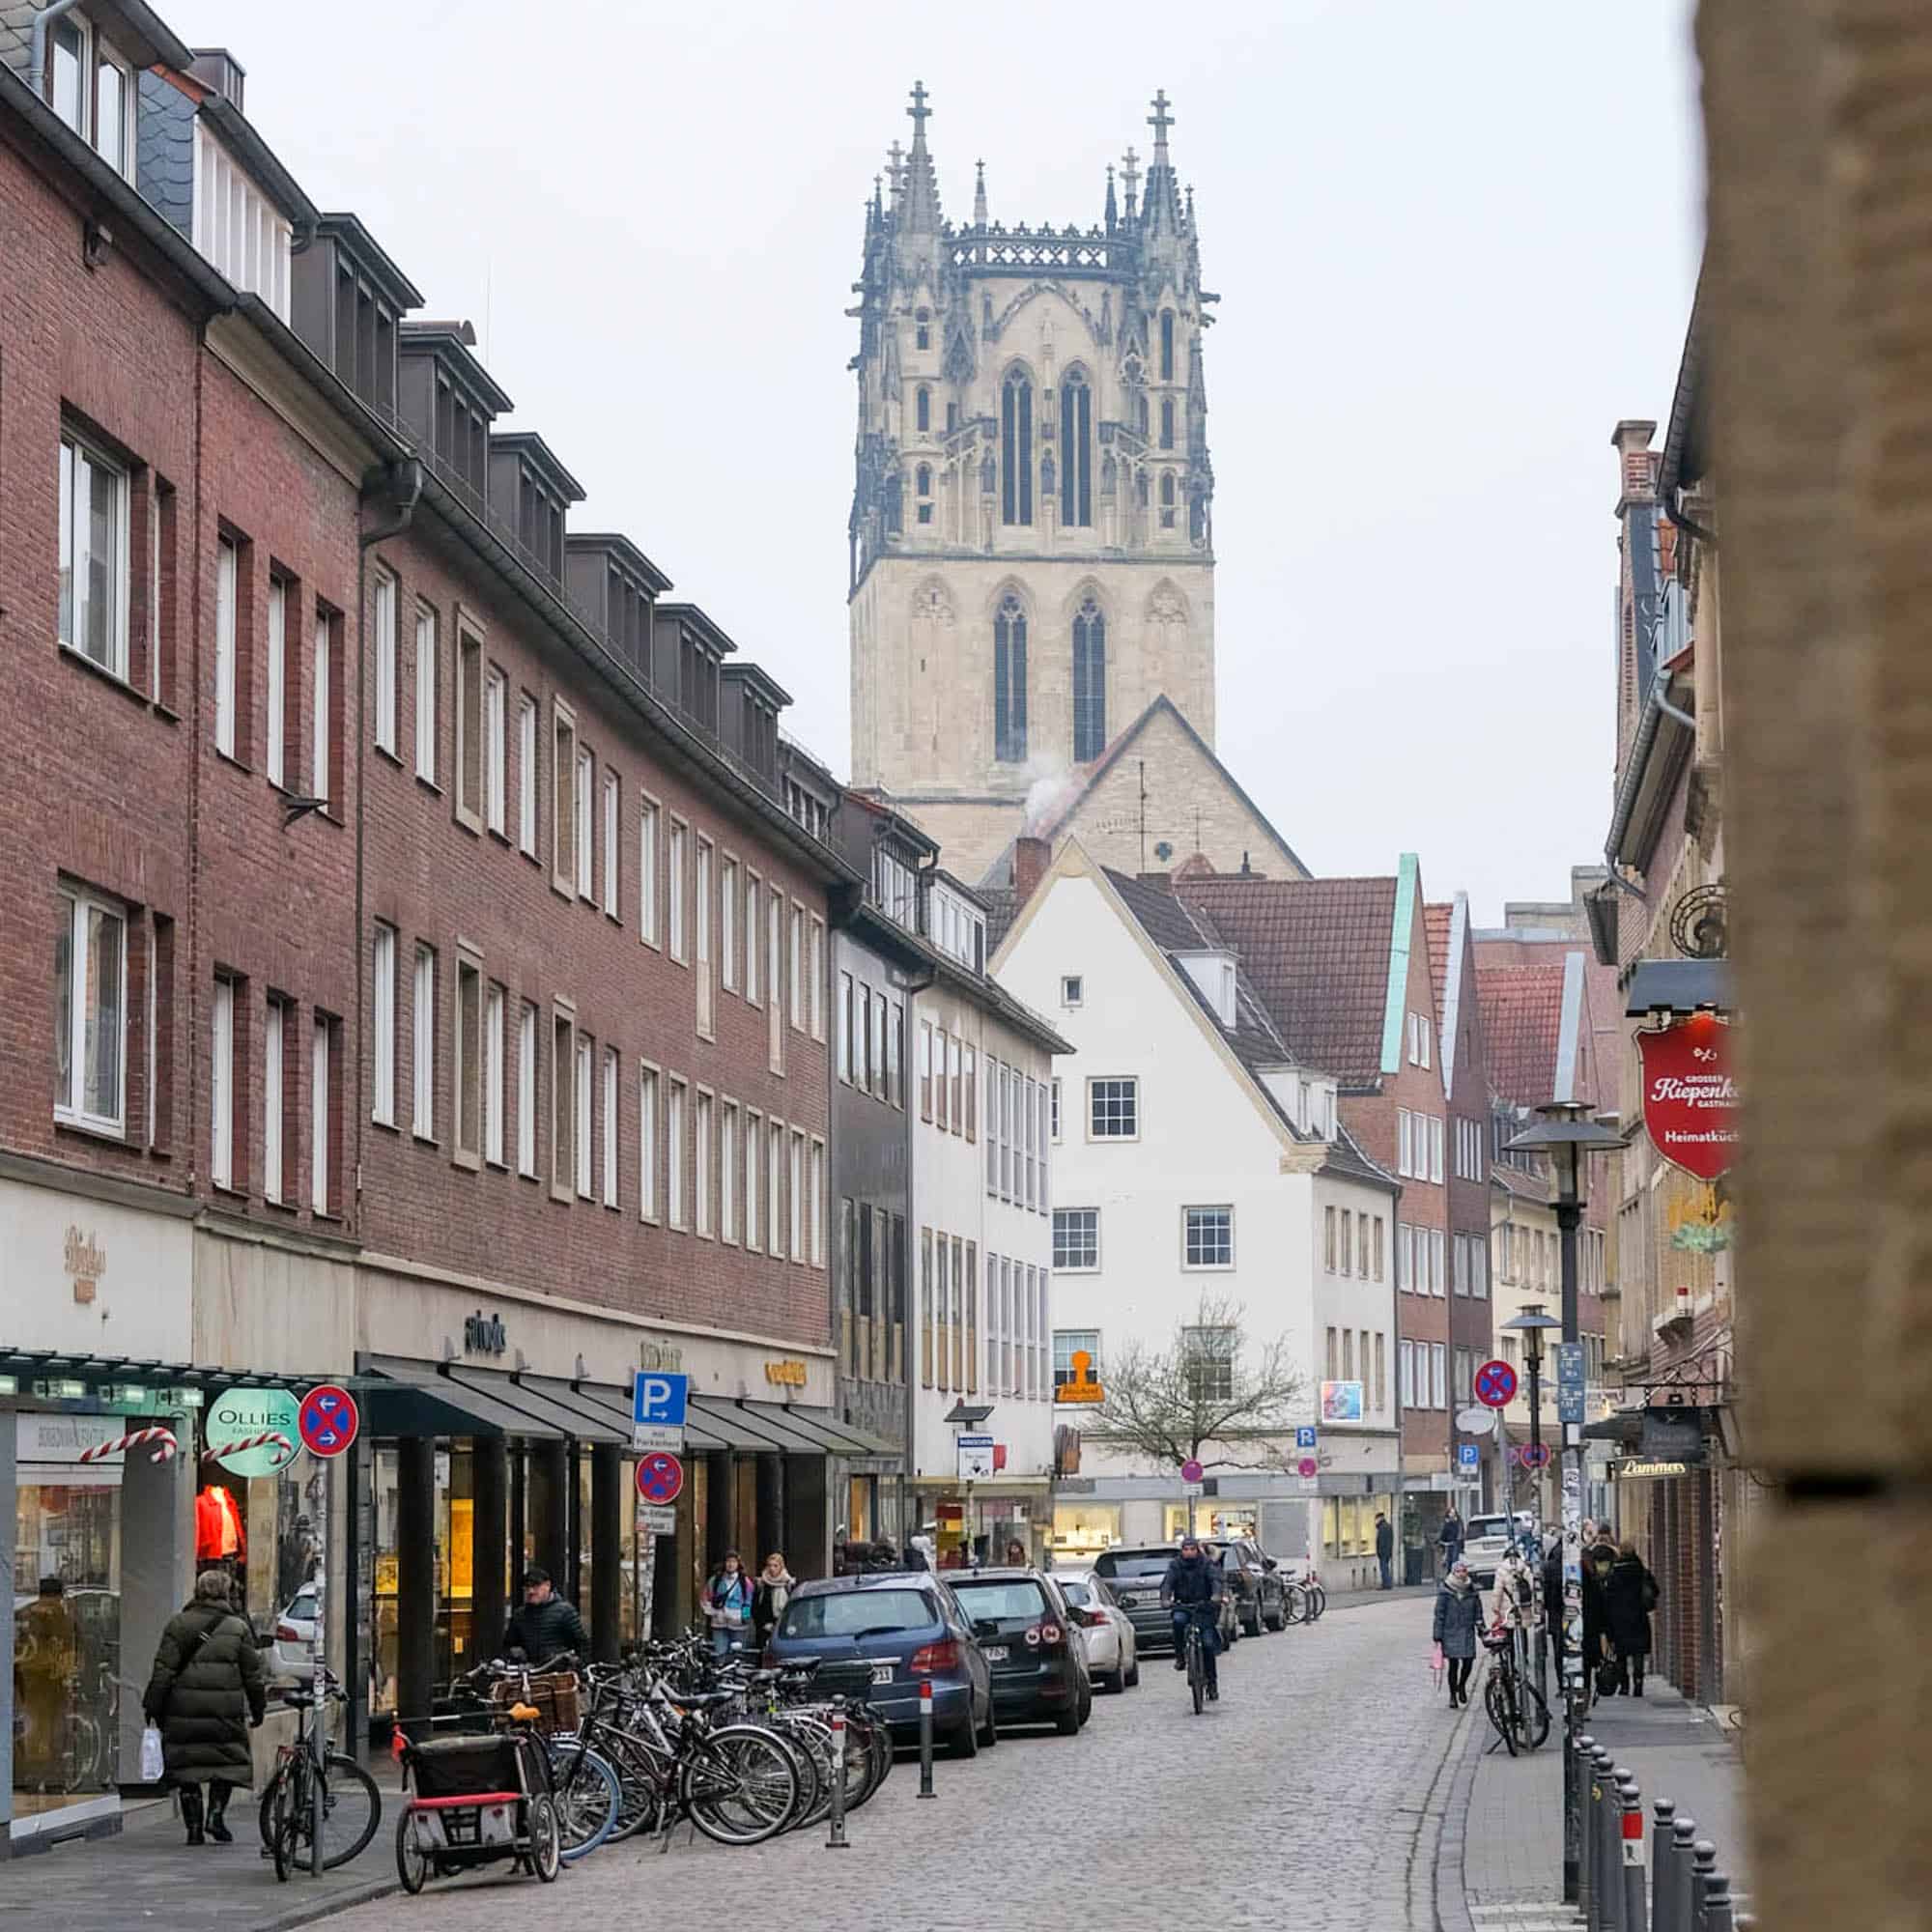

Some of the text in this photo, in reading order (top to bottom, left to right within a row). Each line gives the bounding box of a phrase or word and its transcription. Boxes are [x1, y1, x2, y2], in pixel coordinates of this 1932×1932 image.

[1651, 1077, 1739, 1108] Kiepenk
[642, 1378, 672, 1418] P
[218, 1409, 292, 1426] OLLIES
